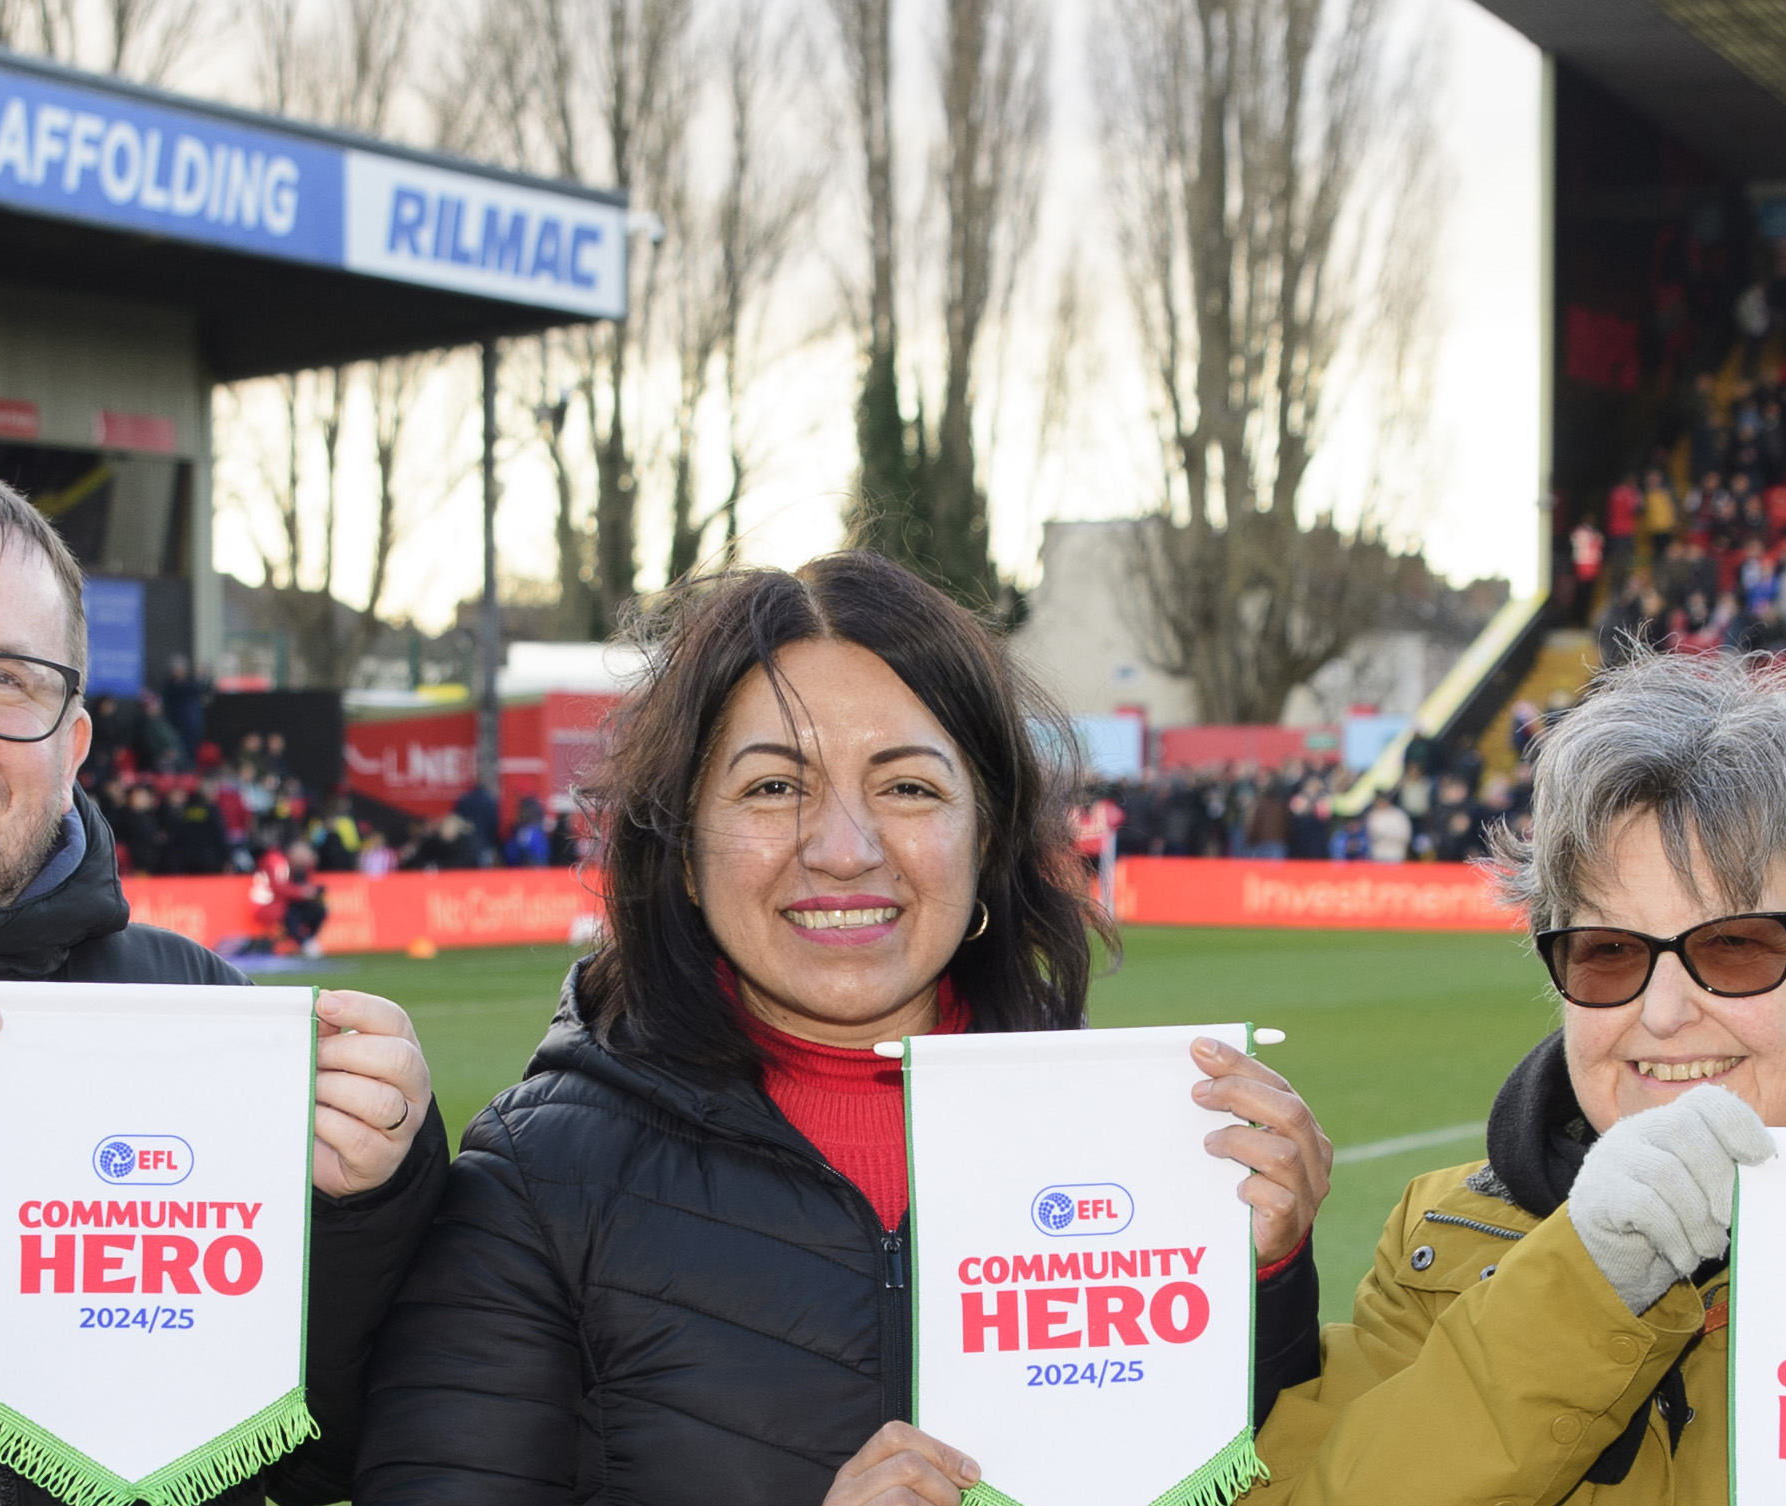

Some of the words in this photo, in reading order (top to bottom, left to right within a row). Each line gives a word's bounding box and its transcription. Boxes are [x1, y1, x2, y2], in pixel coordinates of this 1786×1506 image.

[388, 183, 602, 290] RILMAC
[138, 1150, 178, 1170] EFL
[18, 1200, 263, 1229] COMMUNITY
[1077, 1199, 1118, 1220] EFL
[20, 1234, 264, 1296] HERO
[958, 1246, 1207, 1286] COMMUNITY
[78, 1305, 195, 1334] 2024/25
[960, 1281, 1210, 1354] HERO
[1026, 1359, 1145, 1388] 2024/25
